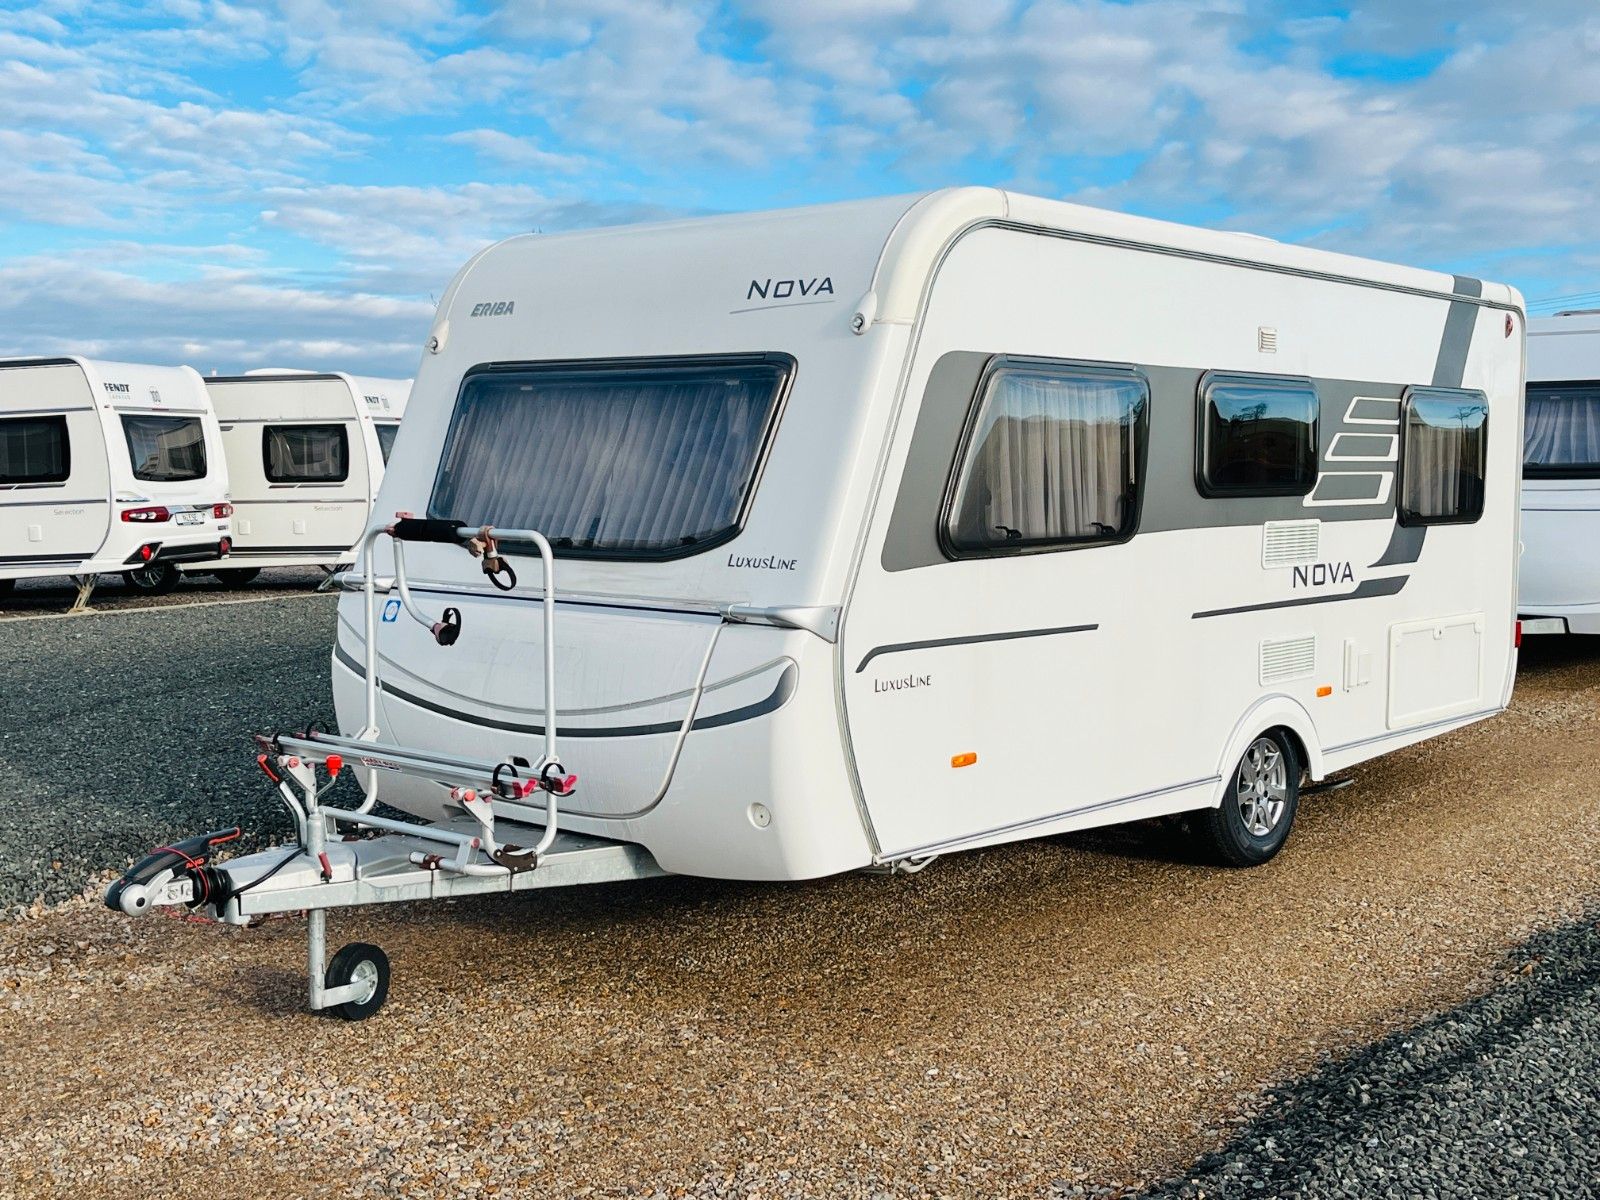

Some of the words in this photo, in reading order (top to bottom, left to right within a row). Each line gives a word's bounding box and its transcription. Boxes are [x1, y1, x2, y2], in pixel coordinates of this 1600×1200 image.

[746, 277, 833, 300] NOVA
[470, 301, 514, 317] ERIBA
[103, 382, 130, 393] FENDT
[1292, 561, 1354, 588] NOVA
